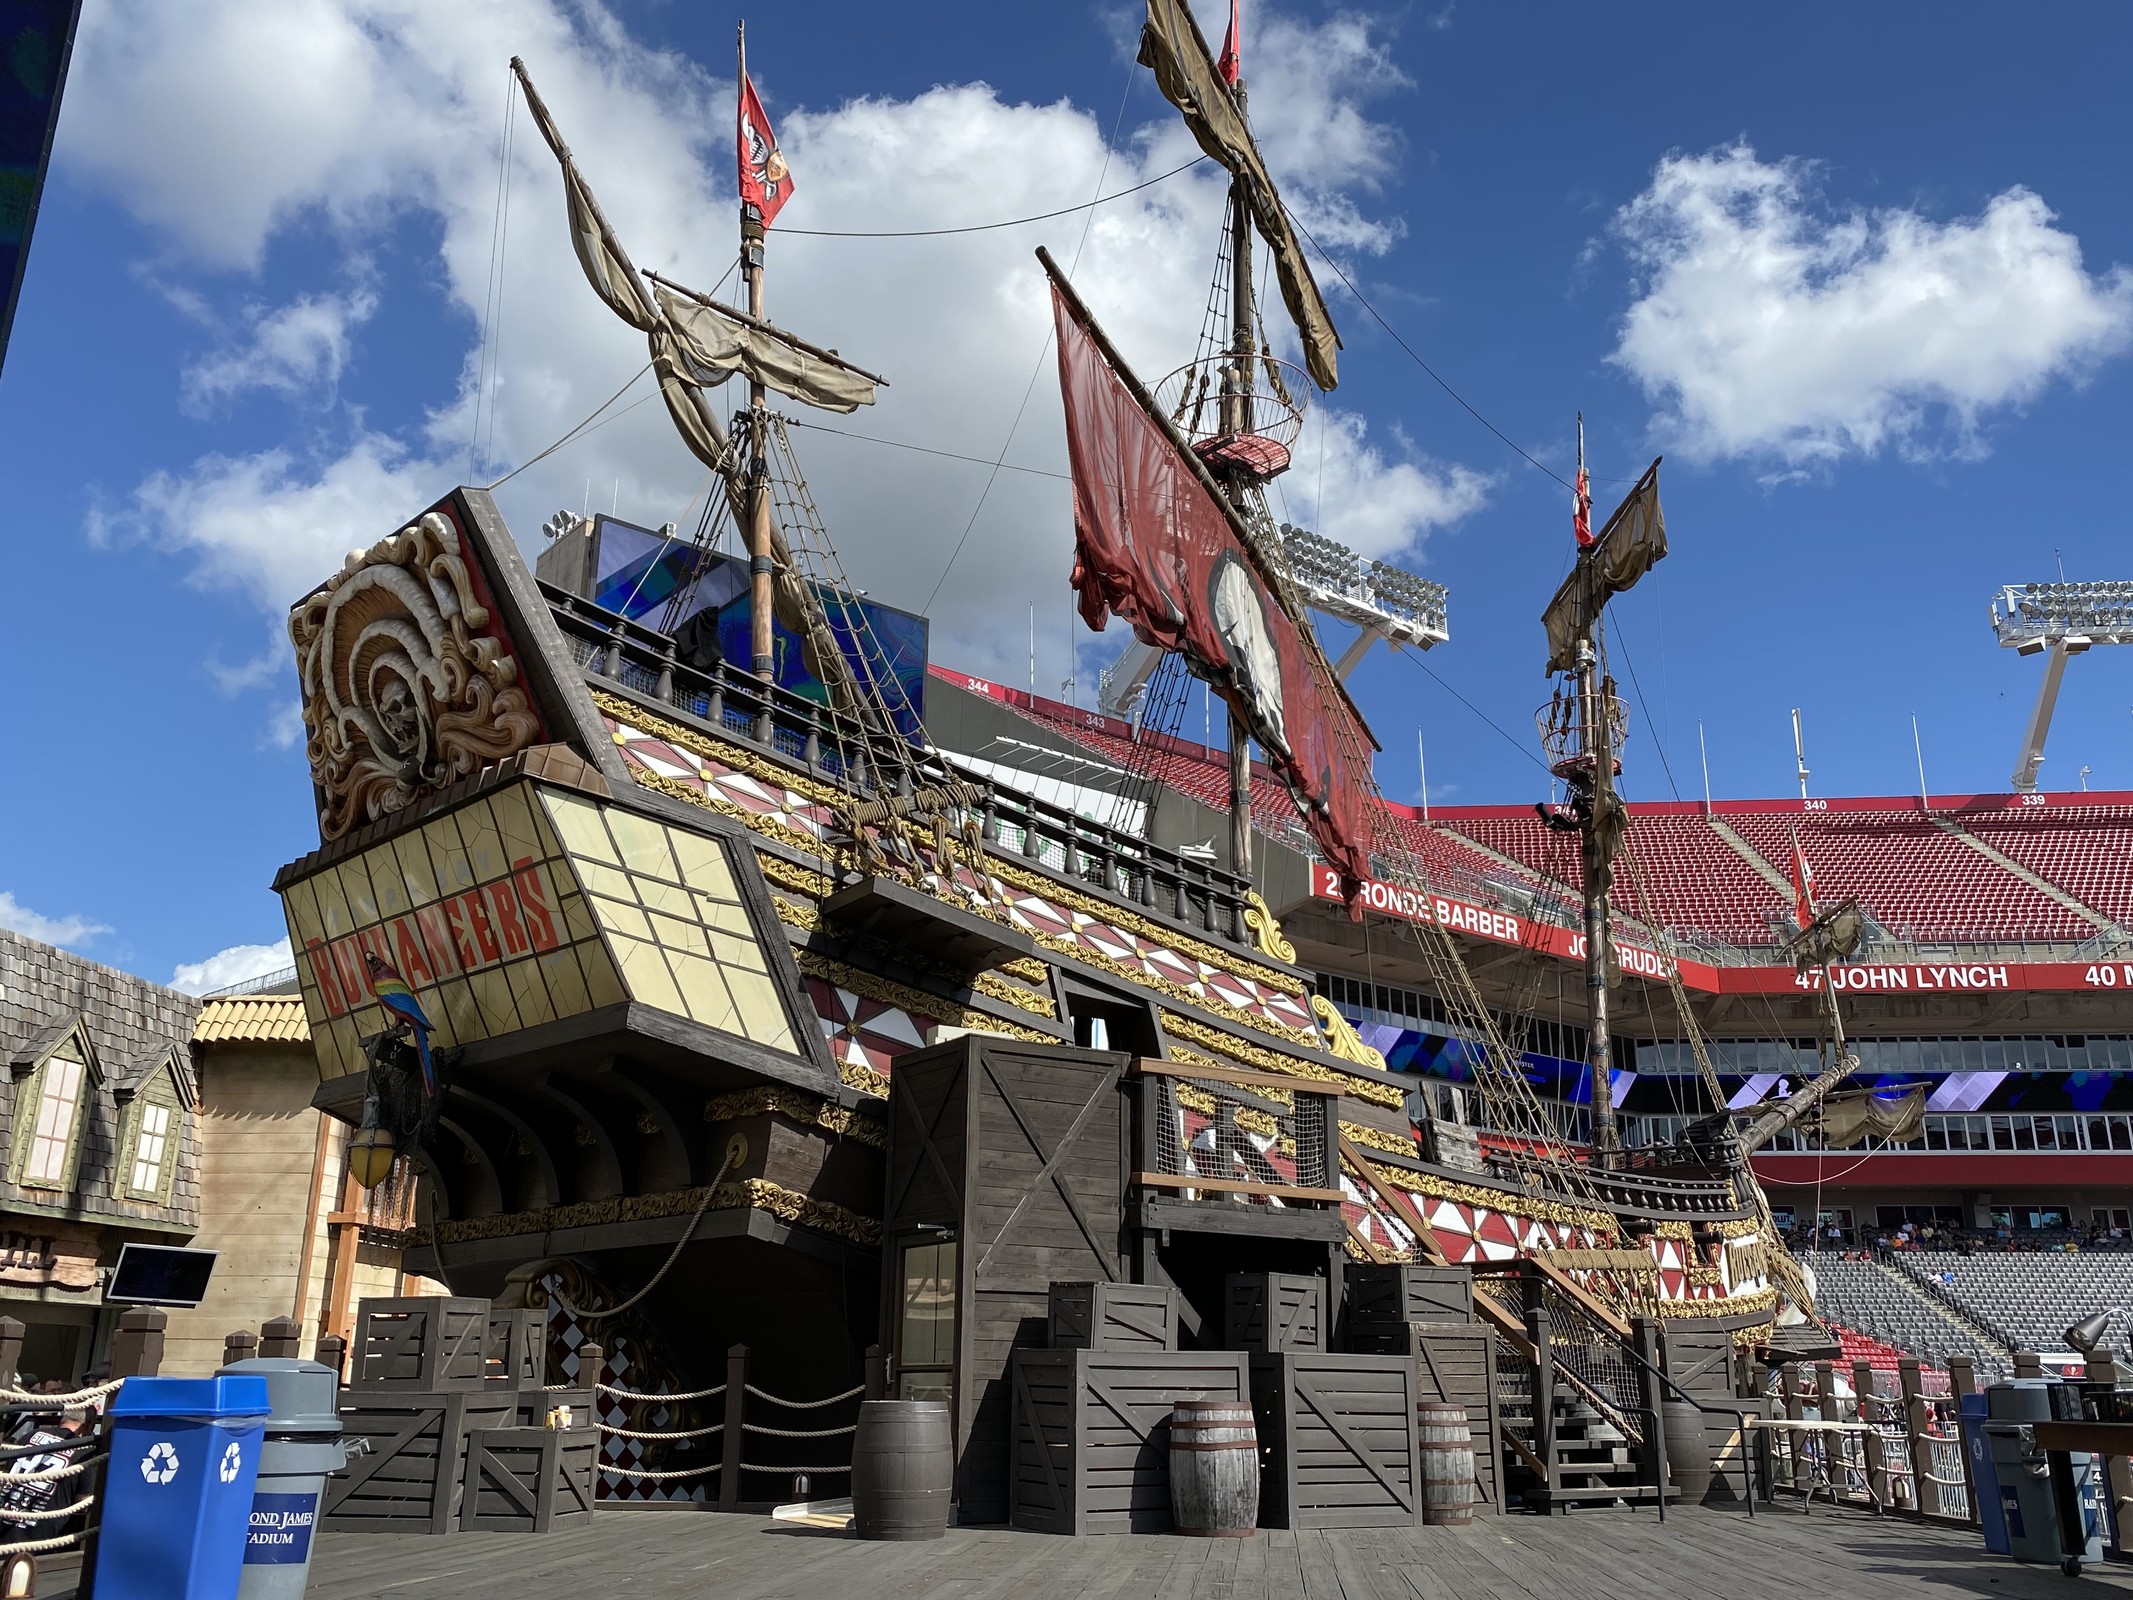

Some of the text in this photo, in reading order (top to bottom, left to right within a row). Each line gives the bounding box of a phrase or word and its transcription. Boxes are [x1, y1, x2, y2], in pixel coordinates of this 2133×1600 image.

[967, 678, 989, 694] 344
[1086, 714, 1105, 729] 343
[1804, 801, 1827, 811] 340
[2022, 795, 2046, 806] 339
[1436, 900, 1519, 942] BARBER
[1795, 966, 2009, 989] 47 JOHN LYNCH
[2085, 965, 2117, 986] 40
[0, 1229, 58, 1272] ILL
[249, 1511, 314, 1530] OND JAMES
